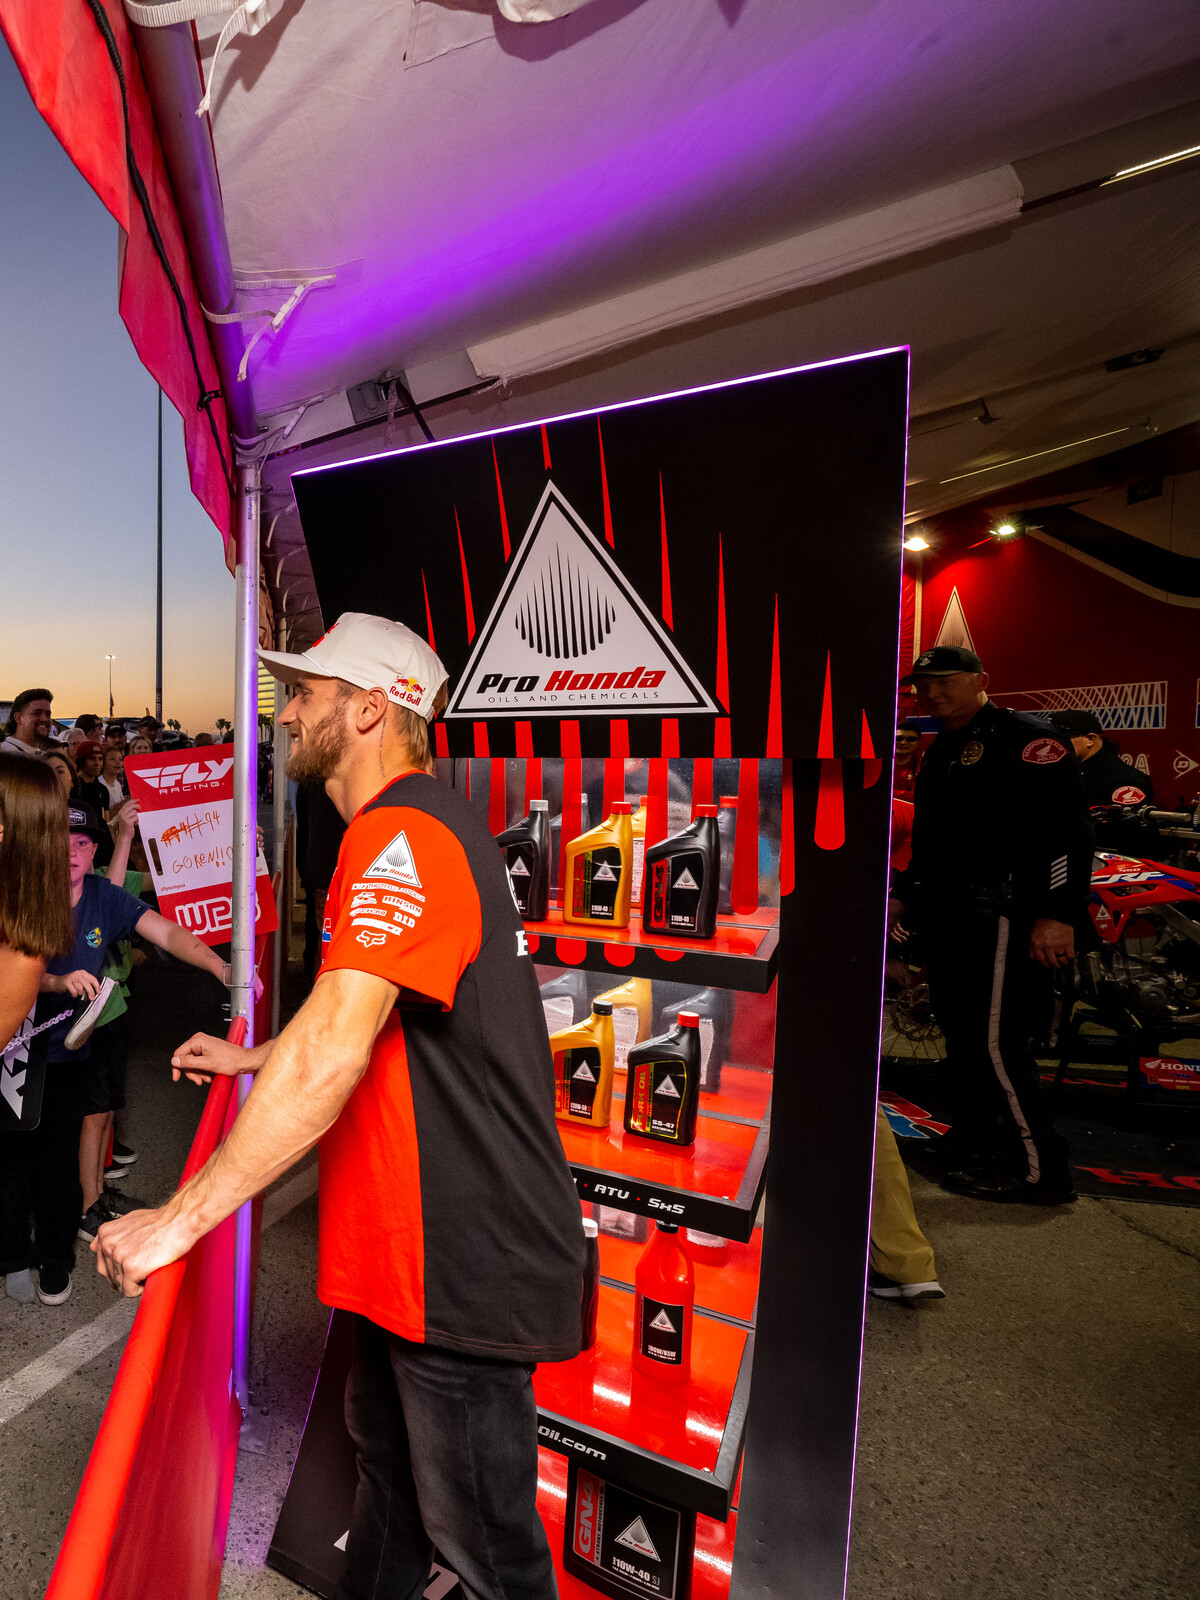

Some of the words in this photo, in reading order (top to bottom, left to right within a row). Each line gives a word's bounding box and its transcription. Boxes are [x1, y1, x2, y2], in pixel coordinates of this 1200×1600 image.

[476, 673, 540, 694] Pro
[543, 666, 667, 692] Honda
[389, 685, 407, 699] Red
[406, 690, 422, 707] Bull
[568, 691, 660, 700] CHEMICALS
[132, 757, 234, 789] FLY
[159, 780, 220, 795] RACING
[388, 868, 414, 880] Honda
[383, 896, 422, 913] HINSON
[653, 864, 665, 923] GN4
[175, 892, 261, 936] WP
[639, 1070, 647, 1089] OIL
[637, 1093, 646, 1126] FORK
[579, 1479, 595, 1555] GN4
[615, 1556, 650, 1581] 10W-40
